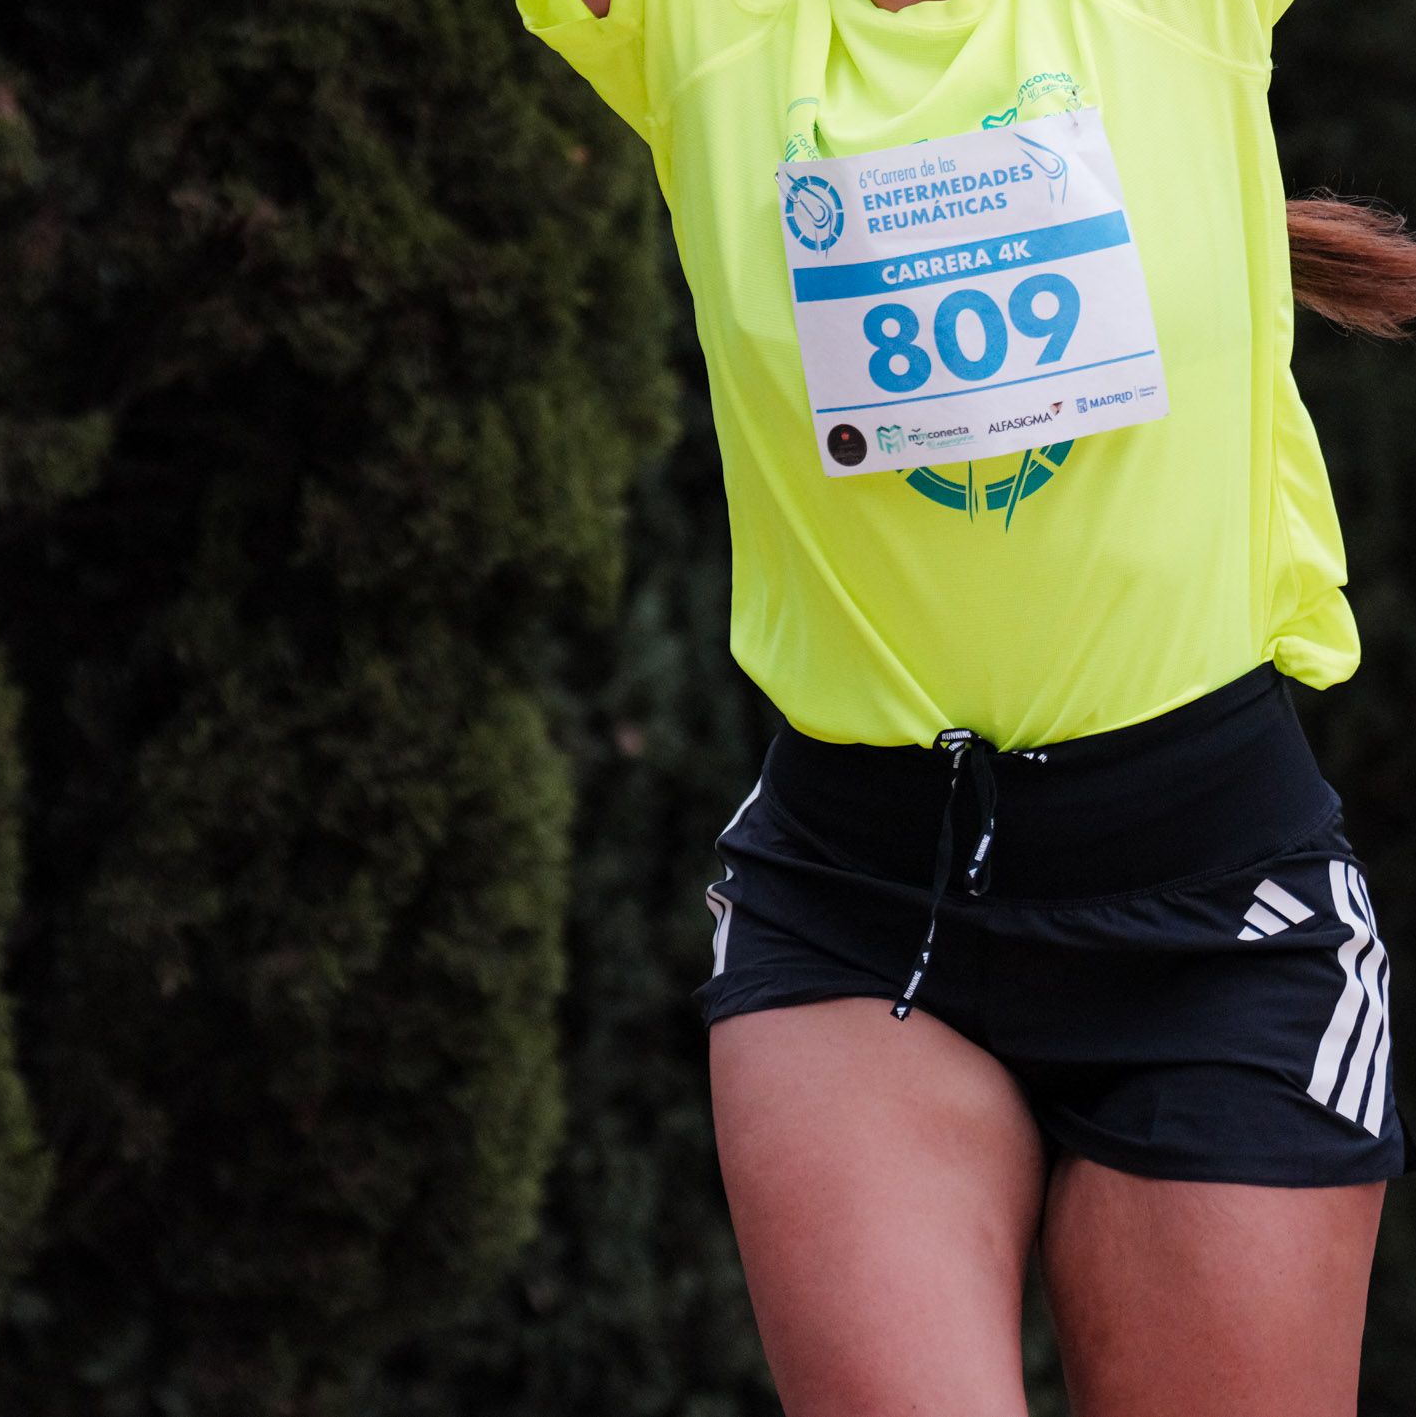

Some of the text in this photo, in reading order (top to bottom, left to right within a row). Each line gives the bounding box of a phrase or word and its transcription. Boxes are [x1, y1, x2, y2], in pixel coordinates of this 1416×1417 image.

[920, 159, 935, 178] de
[938, 156, 957, 173] las
[862, 164, 1034, 212] ENFERMEDADES
[867, 192, 1008, 234] REUMÁTICAS
[881, 239, 1032, 285] CARRERA 4K
[862, 272, 1081, 394] 809
[1089, 391, 1133, 409] MADRID
[988, 412, 1053, 434] ALFASIGMA
[941, 730, 972, 741] RUNNING
[903, 970, 922, 1000] RUNNING
